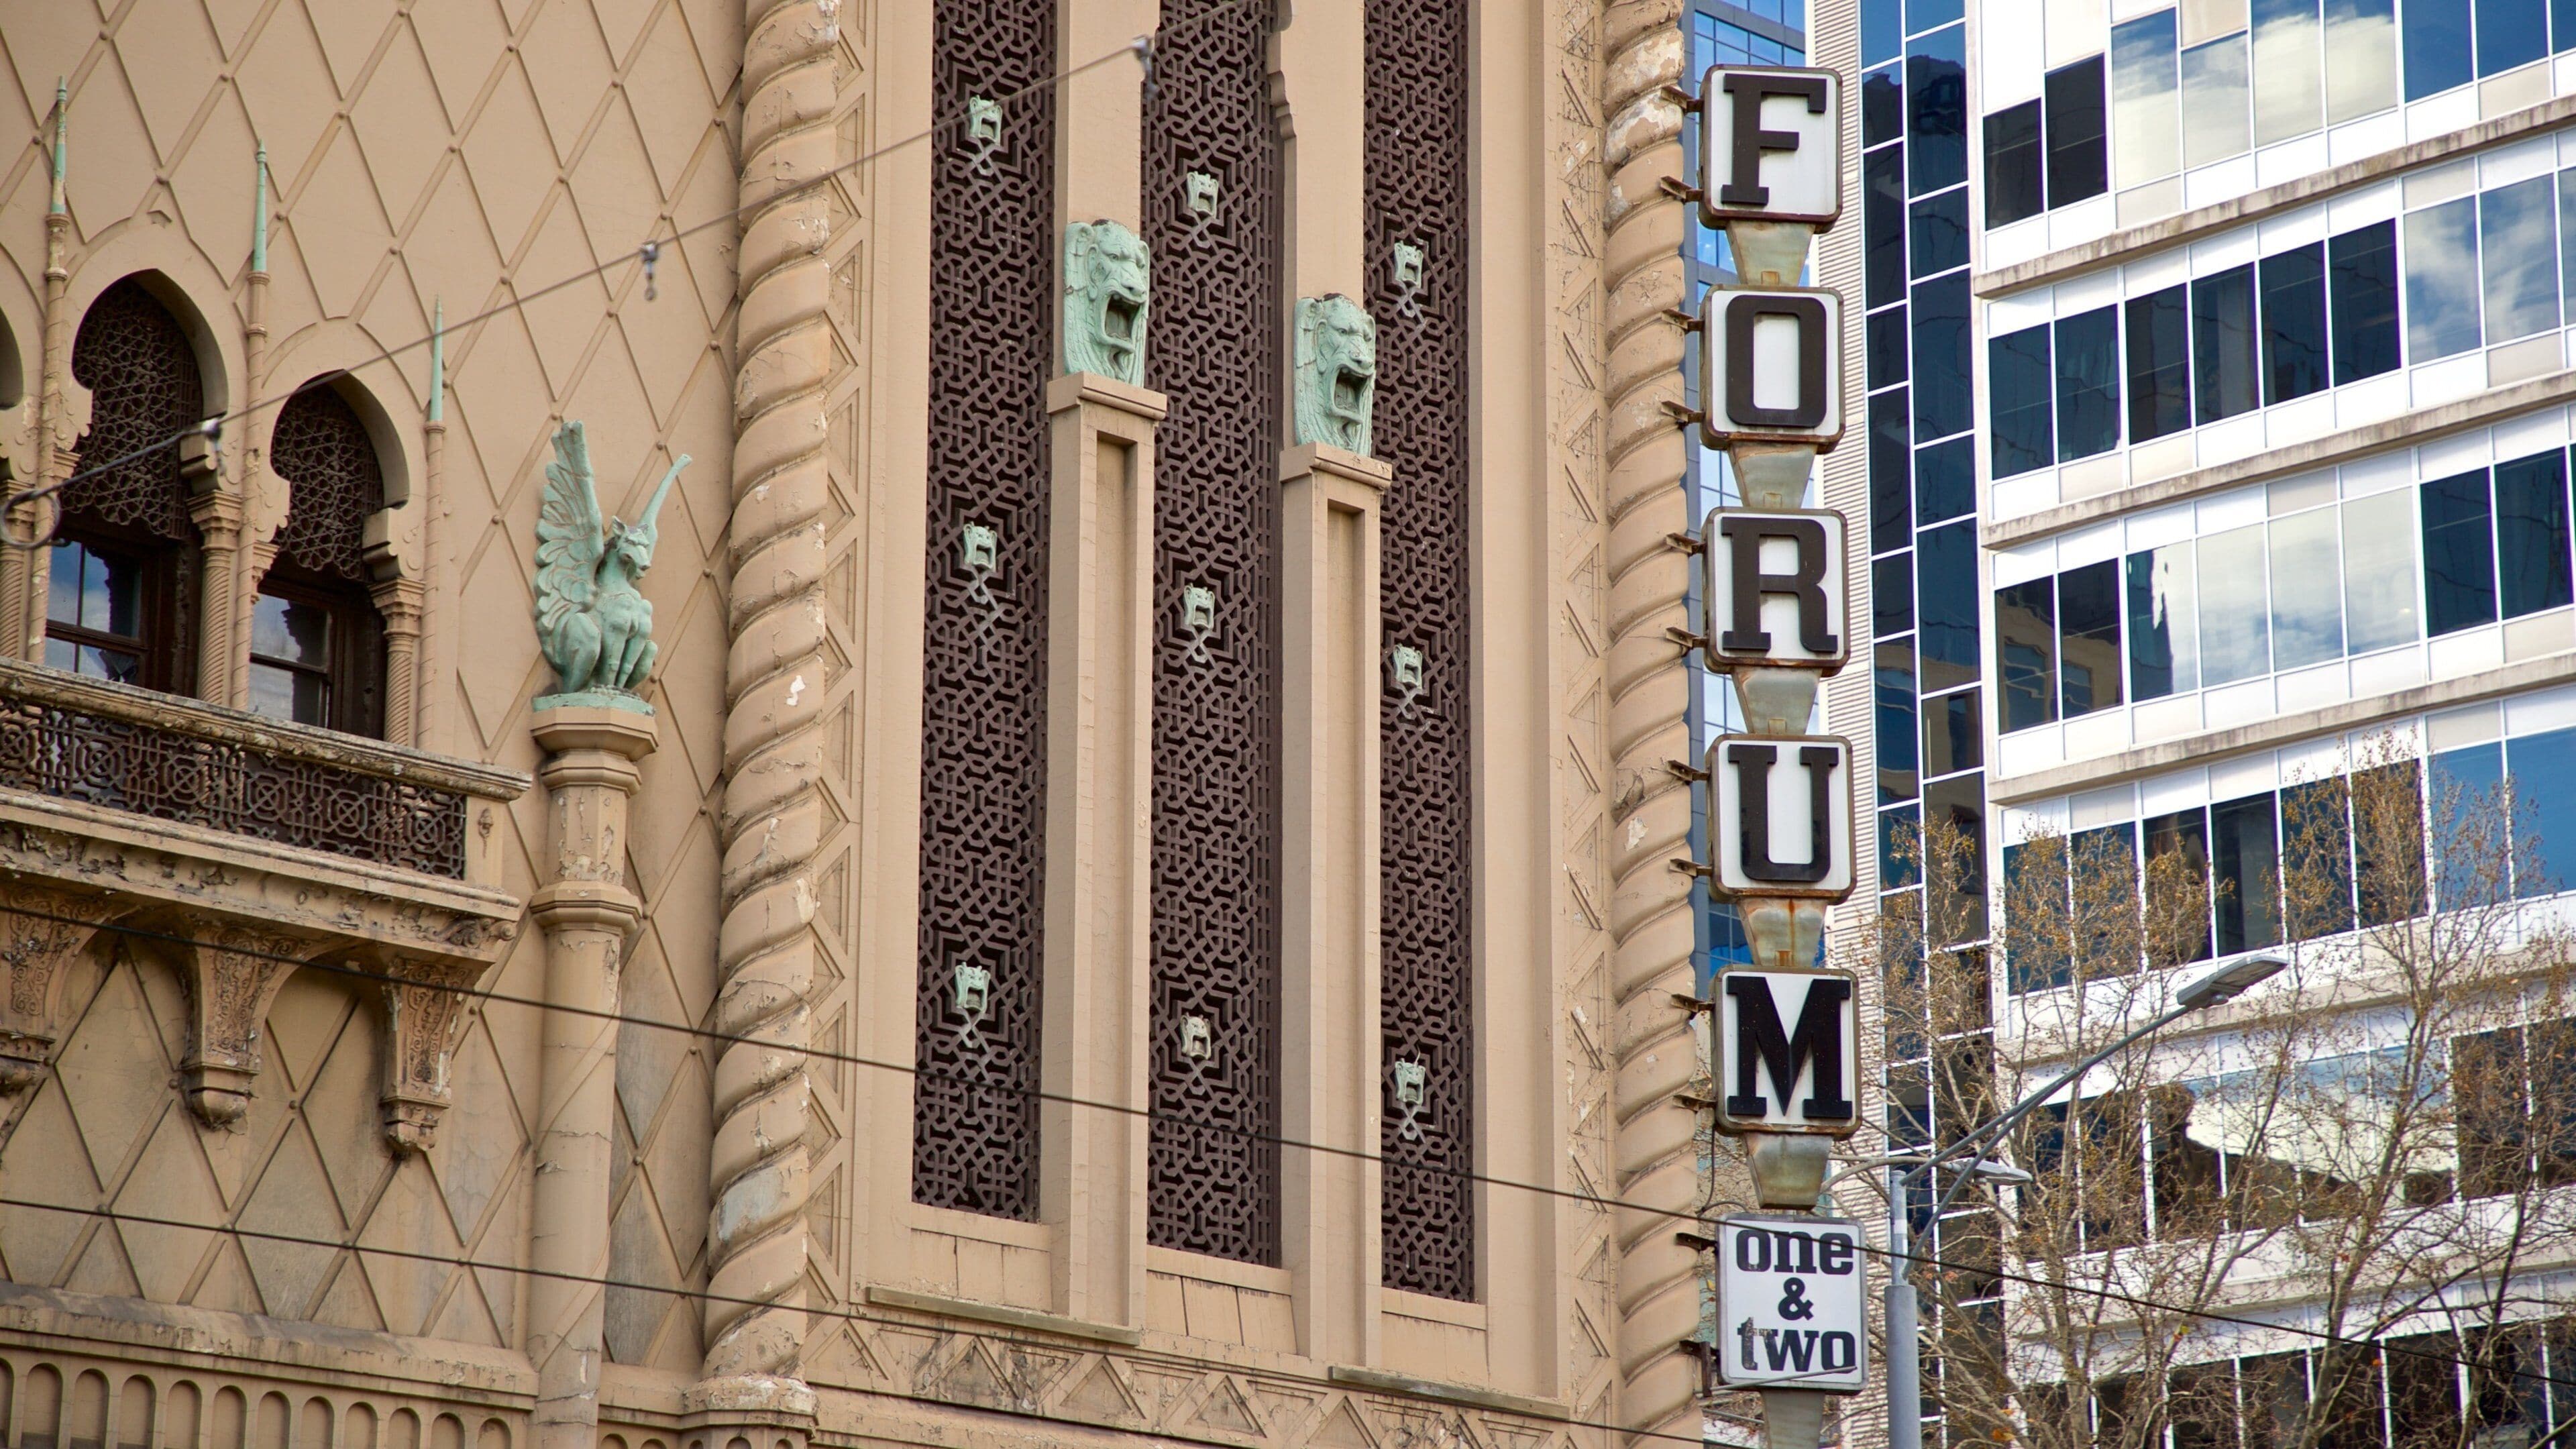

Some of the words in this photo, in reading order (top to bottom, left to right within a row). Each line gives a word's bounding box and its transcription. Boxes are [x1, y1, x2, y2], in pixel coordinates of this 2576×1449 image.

[1721, 72, 1852, 1118] FORUM
[1735, 1228, 1854, 1275] one
[1778, 1277, 1814, 1321] &
[1737, 1316, 1857, 1373] two
